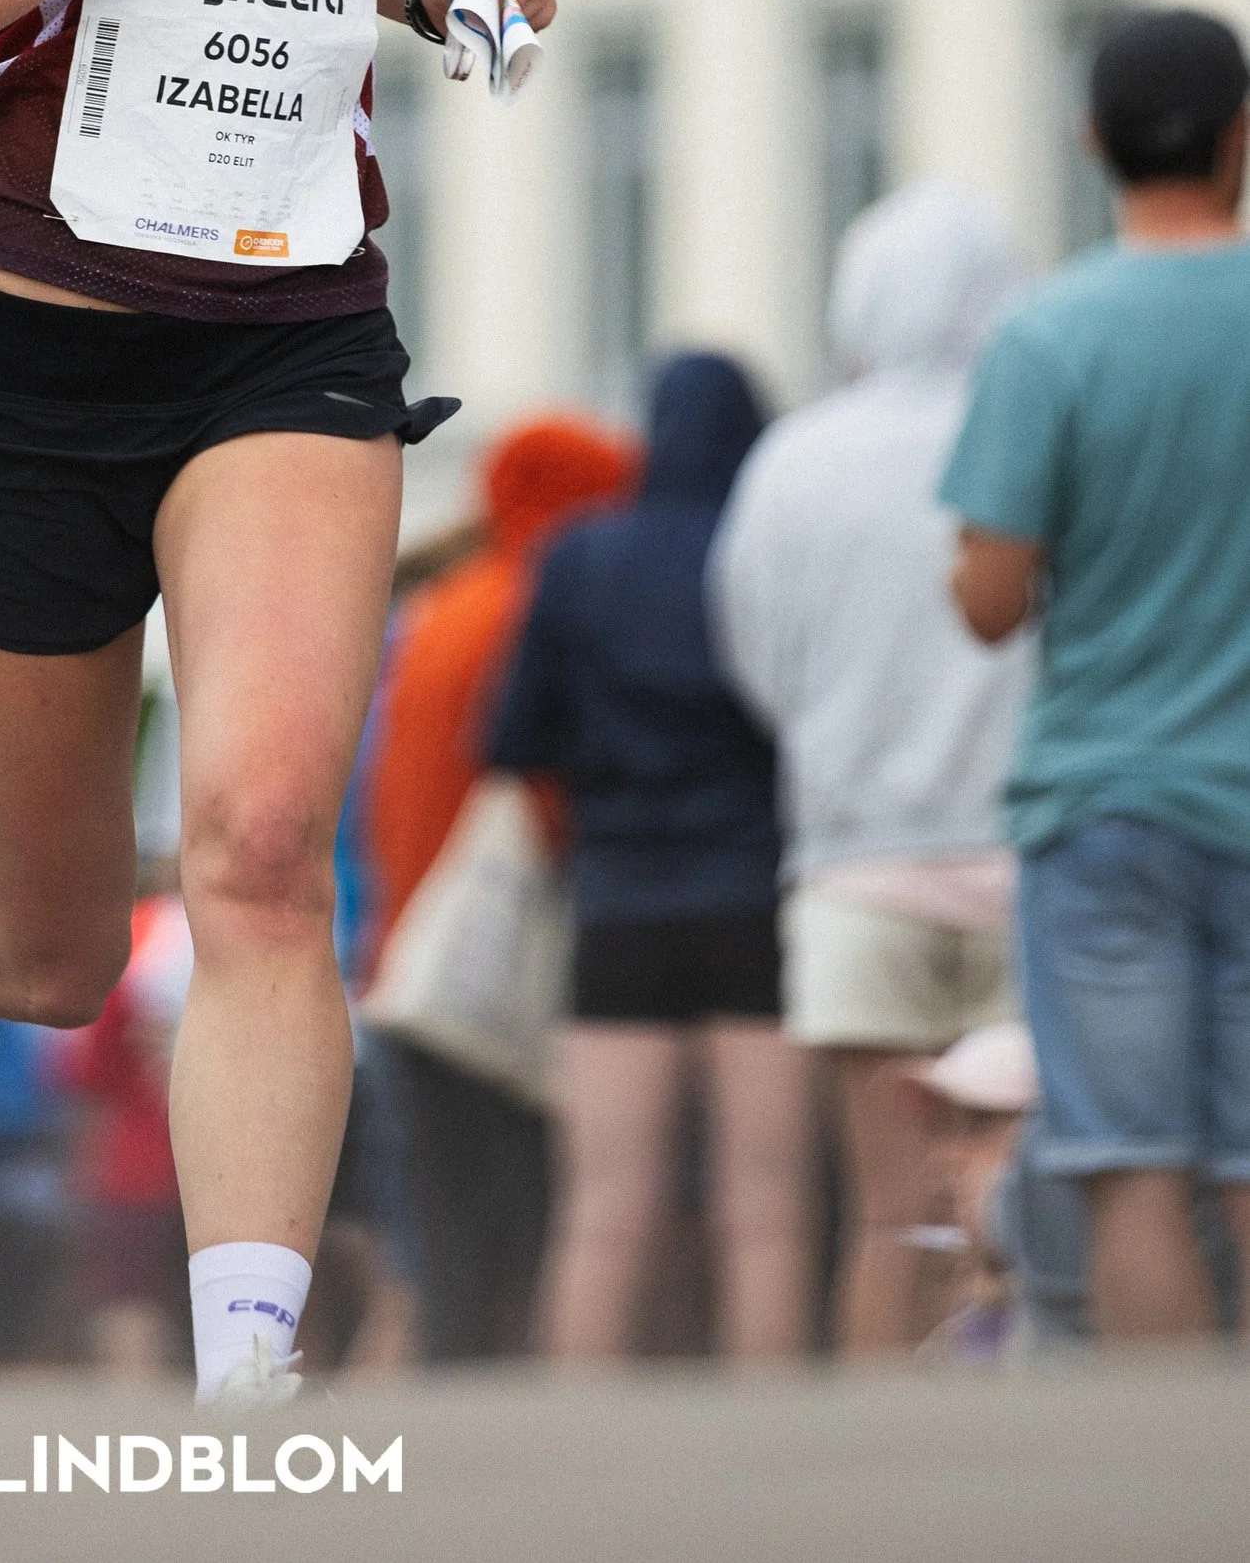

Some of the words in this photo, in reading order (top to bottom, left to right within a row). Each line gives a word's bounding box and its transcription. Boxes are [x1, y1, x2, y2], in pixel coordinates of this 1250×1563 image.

[204, 31, 290, 70] 6056
[155, 74, 303, 122] IZABELLA
[215, 131, 231, 142] OK
[234, 133, 255, 145] TYR
[208, 153, 230, 165] D20
[233, 156, 255, 168] ELIT
[135, 217, 220, 241] CHALMERS
